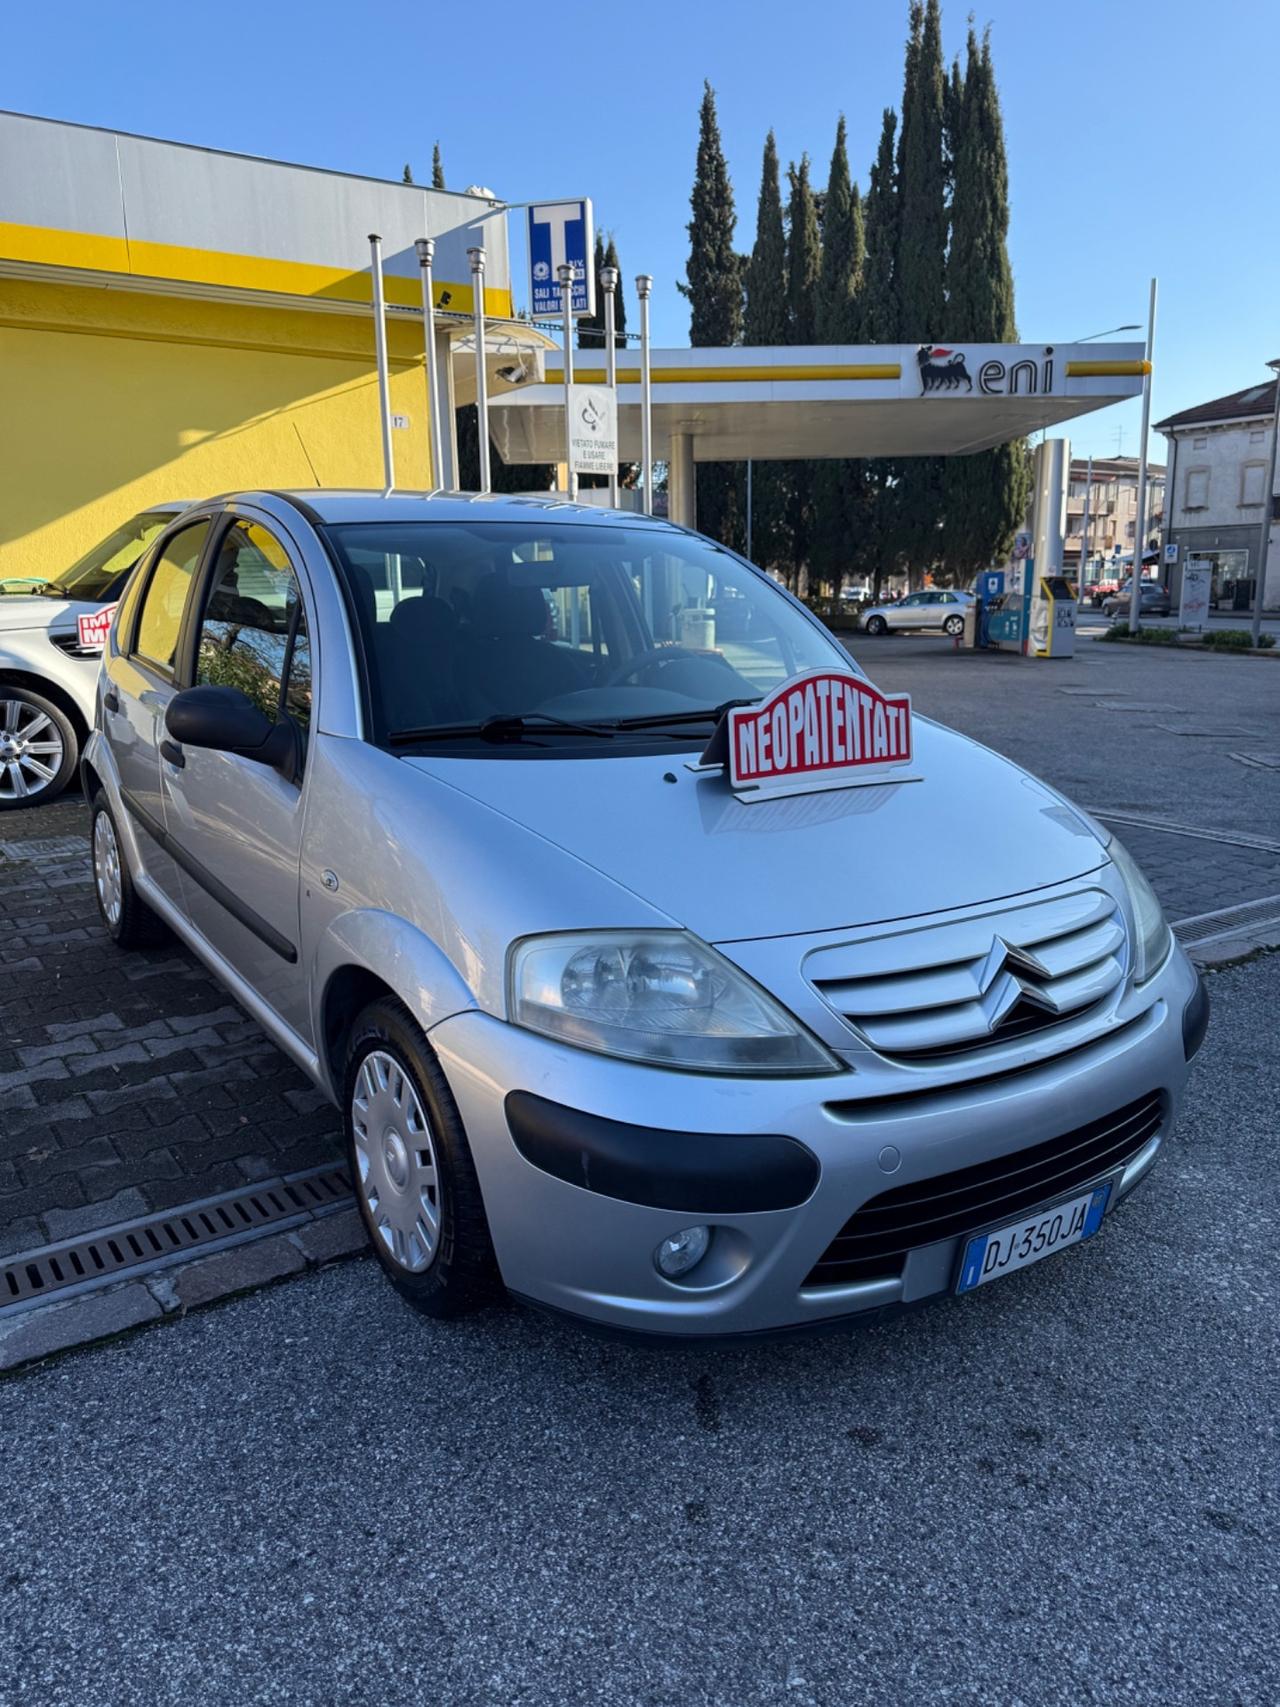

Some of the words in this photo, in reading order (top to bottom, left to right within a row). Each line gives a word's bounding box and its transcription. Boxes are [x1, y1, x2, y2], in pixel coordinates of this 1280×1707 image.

[533, 202, 581, 282] T
[534, 287, 550, 299] SALI
[534, 300, 559, 312] VALORI
[979, 346, 1054, 394] eni
[572, 439, 593, 448] VIETATO
[594, 440, 615, 450] FUMARE
[588, 450, 606, 460] USARE
[575, 461, 594, 470] FIAMME
[595, 462, 614, 471] LIBERE
[738, 679, 908, 775] NEOPATENTATI
